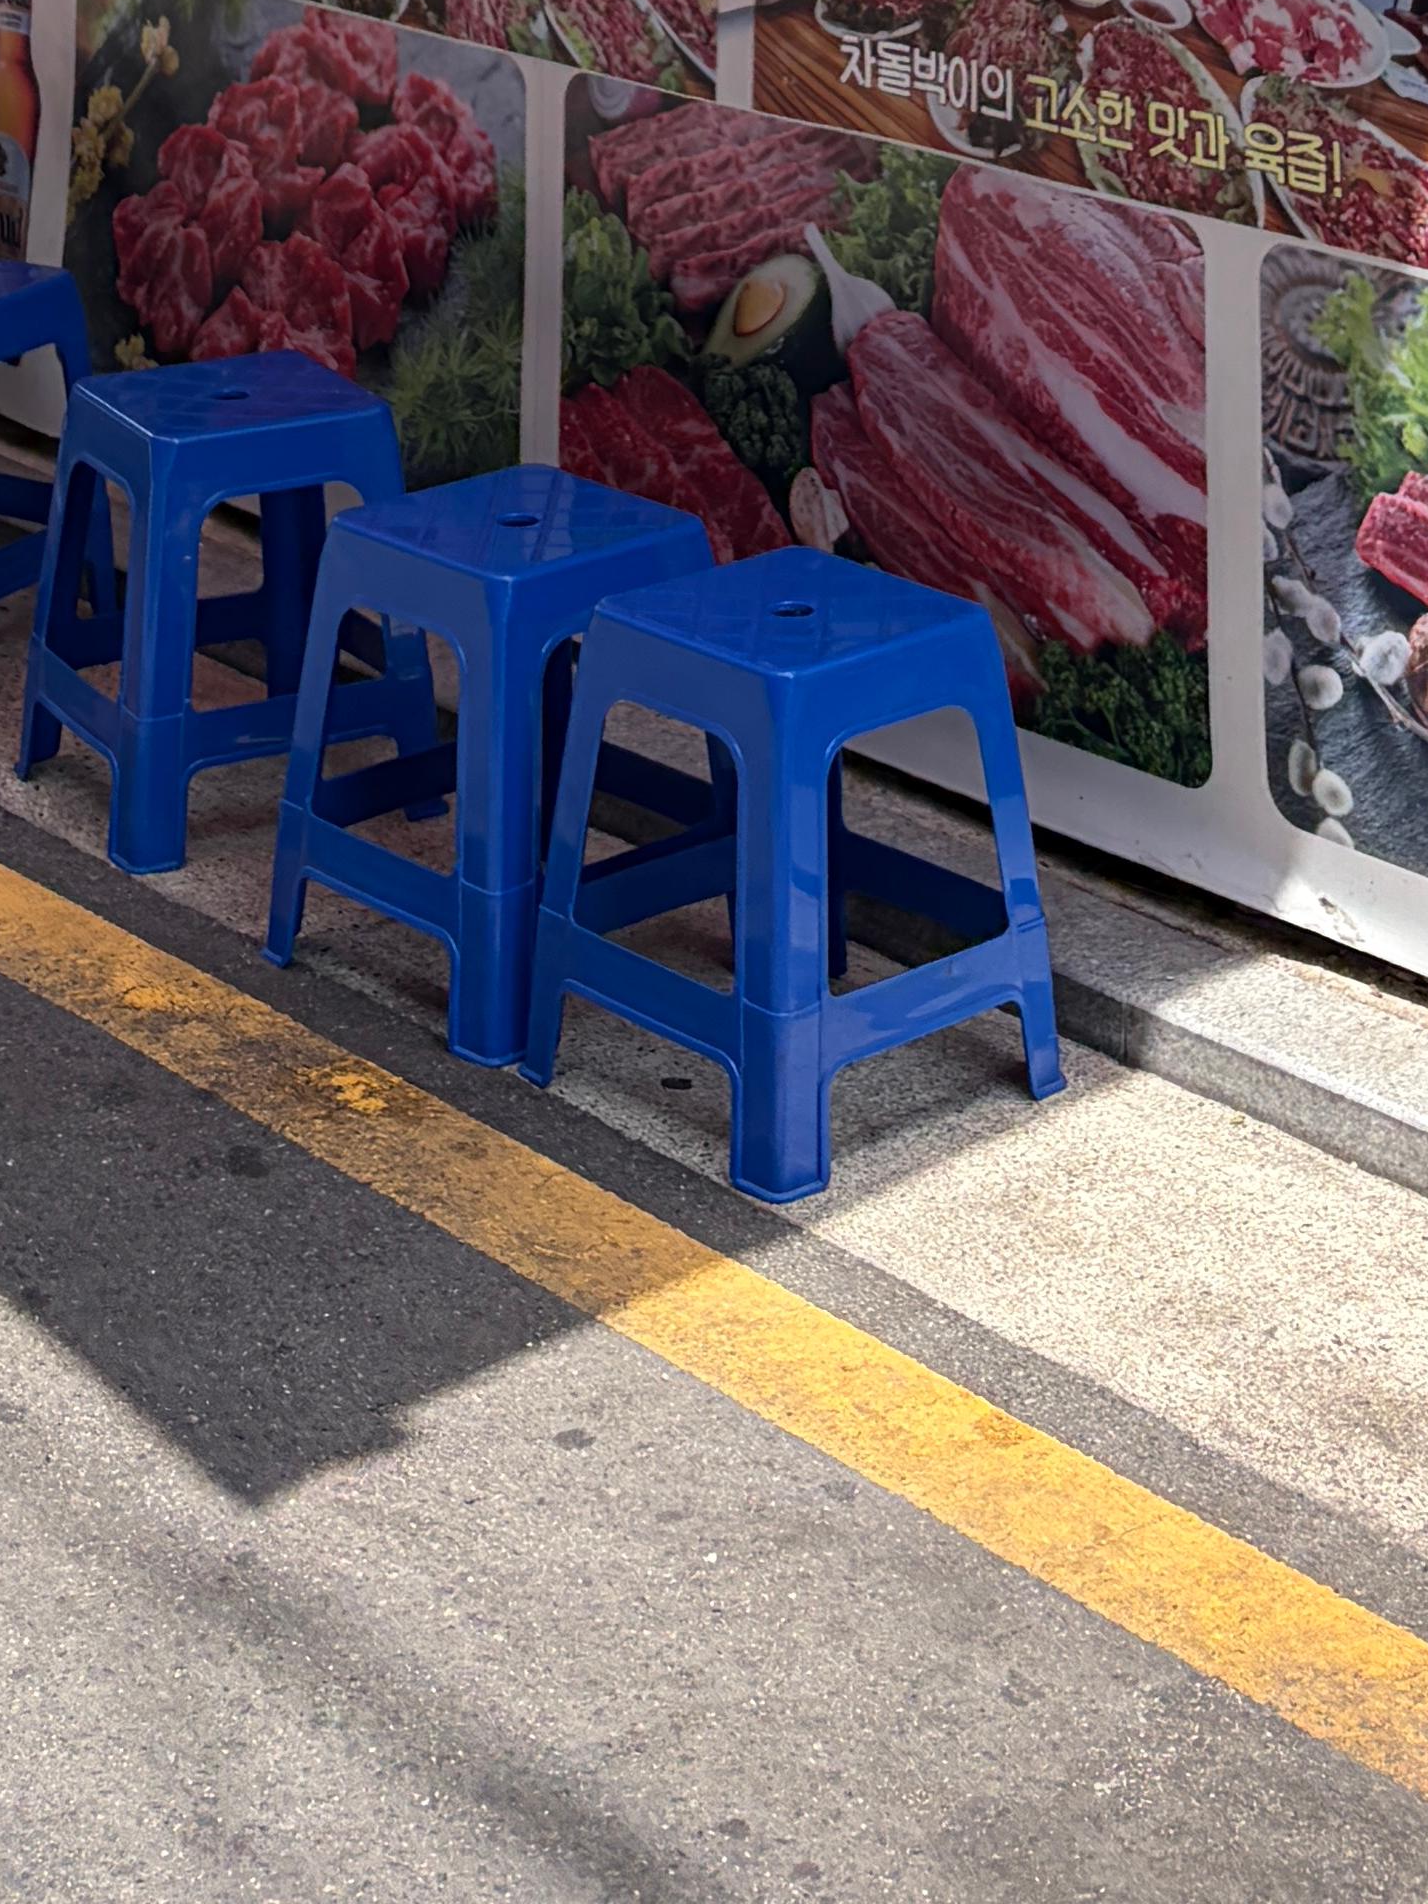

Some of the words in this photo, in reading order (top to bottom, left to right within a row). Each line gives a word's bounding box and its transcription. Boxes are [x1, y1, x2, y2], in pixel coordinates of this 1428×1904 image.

[839, 33, 1015, 123] 차돌박이의
[1023, 74, 1135, 153] 고소한
[1147, 100, 1230, 172] 맛과
[1243, 127, 1344, 199] 육즙!
